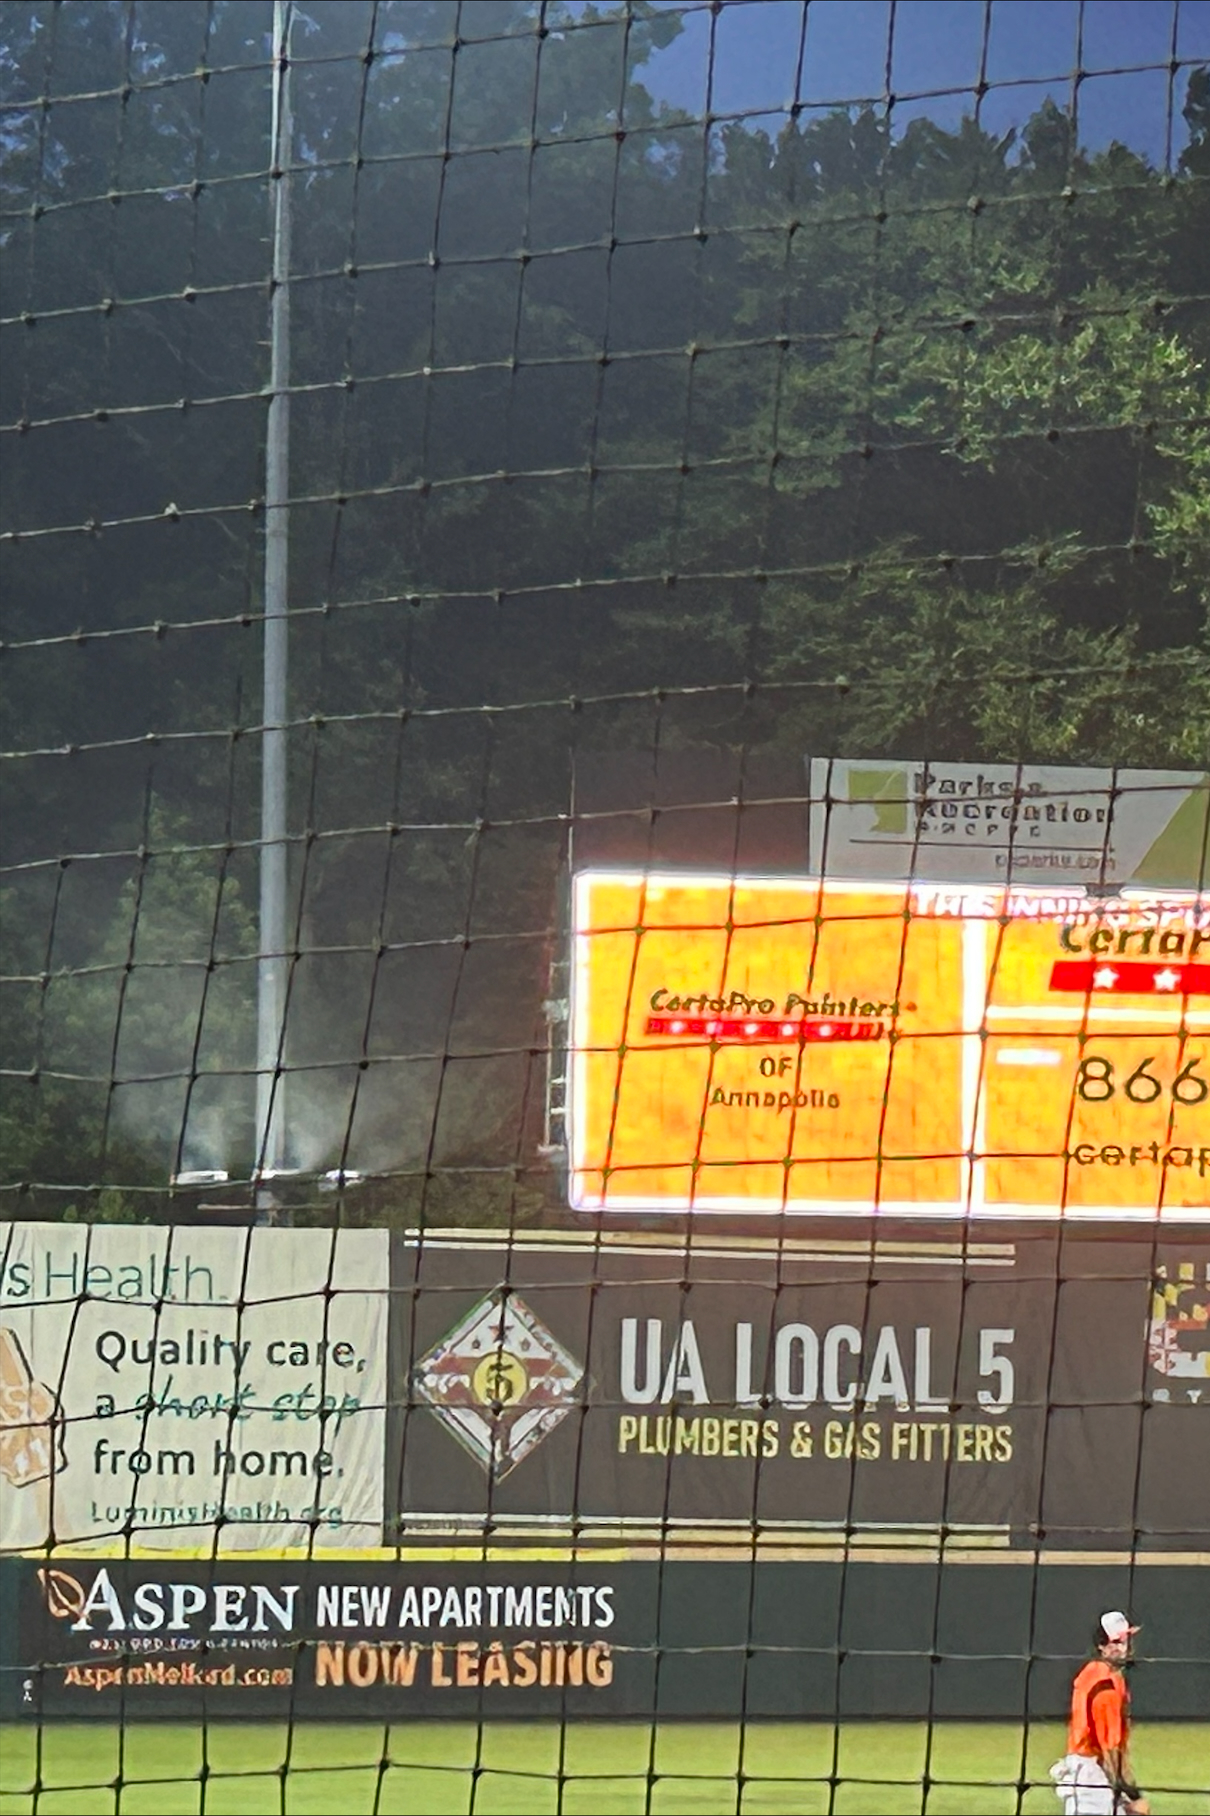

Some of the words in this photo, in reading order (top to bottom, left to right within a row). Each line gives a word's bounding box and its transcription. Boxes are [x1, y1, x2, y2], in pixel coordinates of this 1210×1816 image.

[914, 772, 1016, 796] Parks
[914, 894, 996, 917] THIS
[650, 988, 775, 1016] CertaPro
[759, 1057, 793, 1078] OF
[1078, 1056, 1208, 1105] 866
[709, 1088, 841, 1116] Annapolis
[96, 1329, 250, 1373] Quality
[266, 1340, 367, 1373] care,
[621, 1318, 709, 1405] UA
[735, 1322, 952, 1414] LOCAL
[976, 1328, 1017, 1415] 5
[95, 1393, 115, 1419] a
[134, 1373, 257, 1421] short
[272, 1381, 362, 1438] stop
[93, 1440, 195, 1476] from
[213, 1440, 344, 1477] home.
[618, 1415, 780, 1460] PLUMBERS
[790, 1421, 814, 1459] &
[823, 1420, 882, 1461] GAS
[891, 1422, 1013, 1463] FITTERS
[71, 1567, 301, 1632] ASPEN
[316, 1585, 394, 1628] NEW
[399, 1584, 615, 1629] APARTMENTS
[314, 1641, 416, 1688] NOW
[431, 1641, 614, 1689] LEASING
